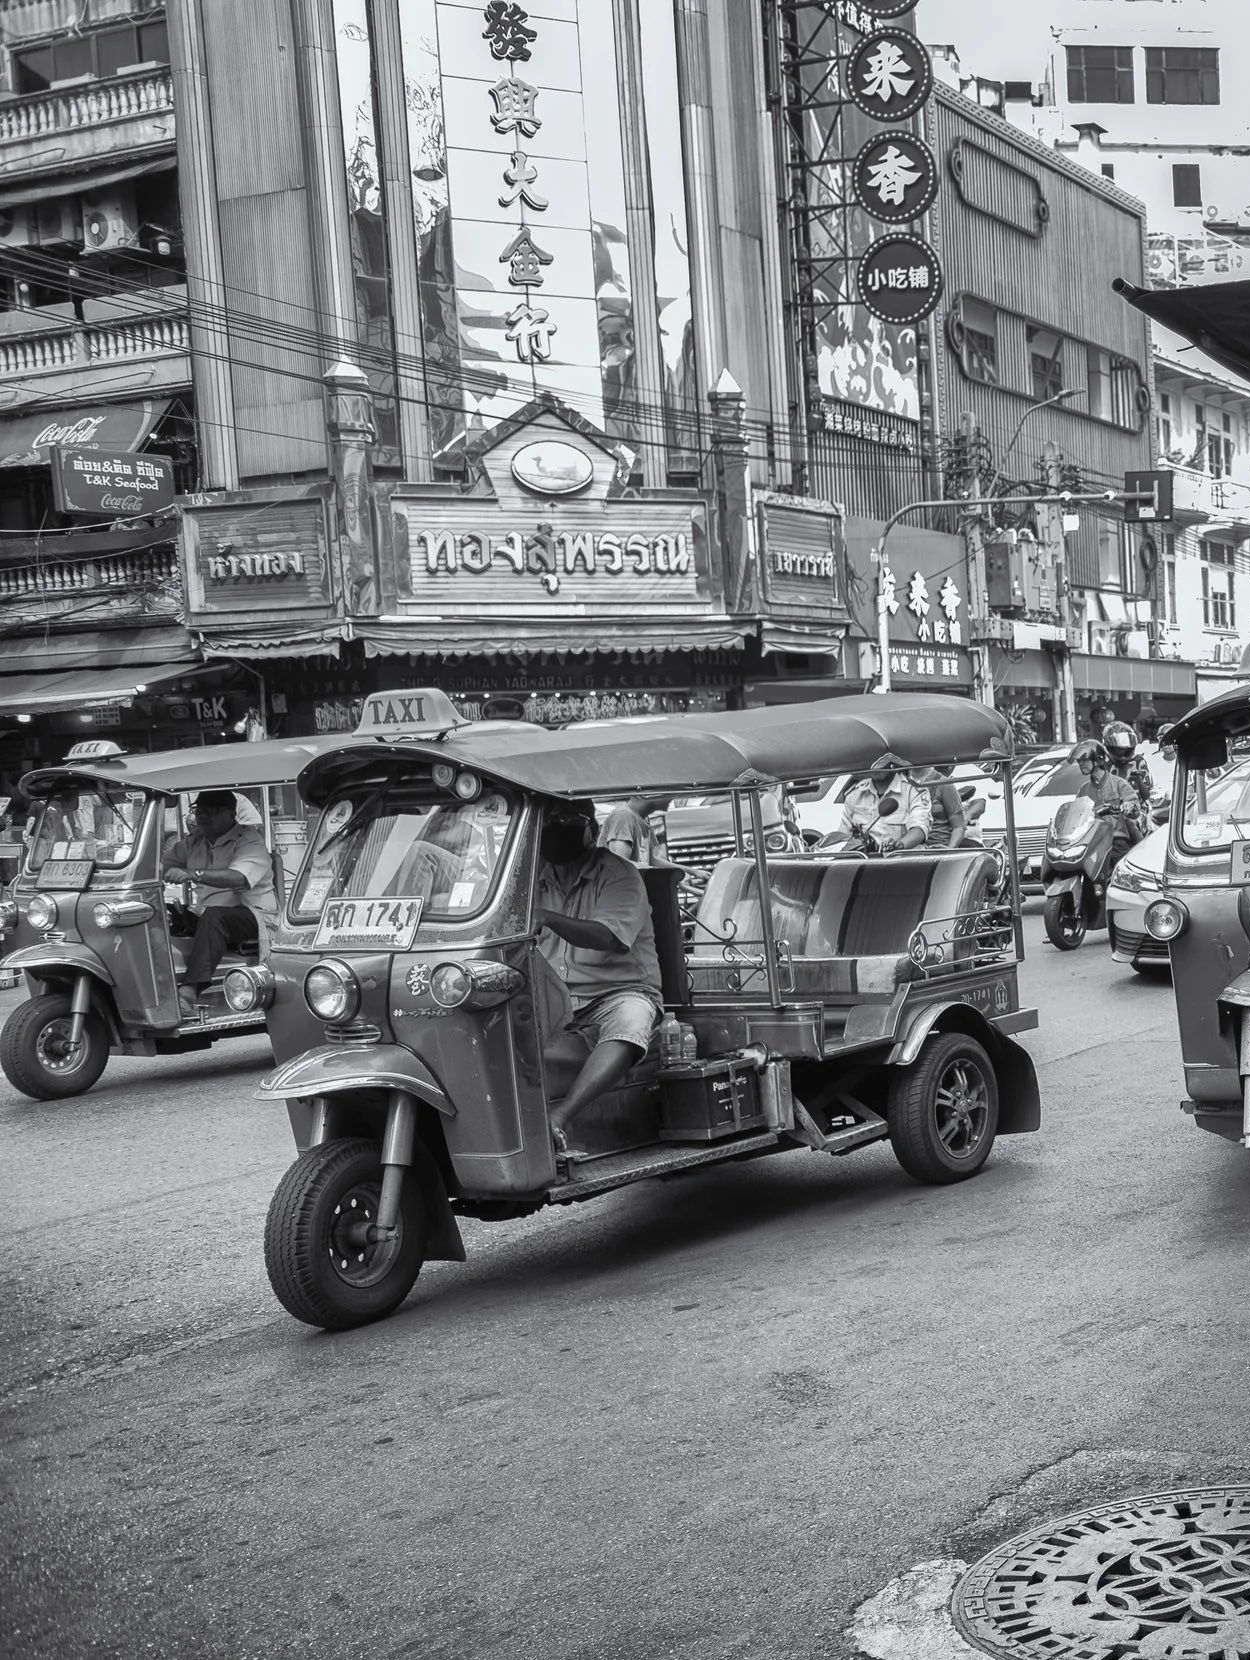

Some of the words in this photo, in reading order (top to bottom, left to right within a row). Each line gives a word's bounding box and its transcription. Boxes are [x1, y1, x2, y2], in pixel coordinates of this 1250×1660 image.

[868, 266, 929, 291] 小吃铺
[83, 474, 112, 487] T&K
[114, 477, 159, 492] Seafood
[207, 542, 304, 578] ห้างทอง
[418, 522, 690, 596] ทองสุพรรณ
[775, 551, 834, 577] เยาวราช
[190, 696, 228, 721] T&K
[368, 697, 427, 725] TAXI
[71, 742, 101, 755] TAXI
[61, 863, 90, 877] 6303
[365, 902, 416, 928] 1741
